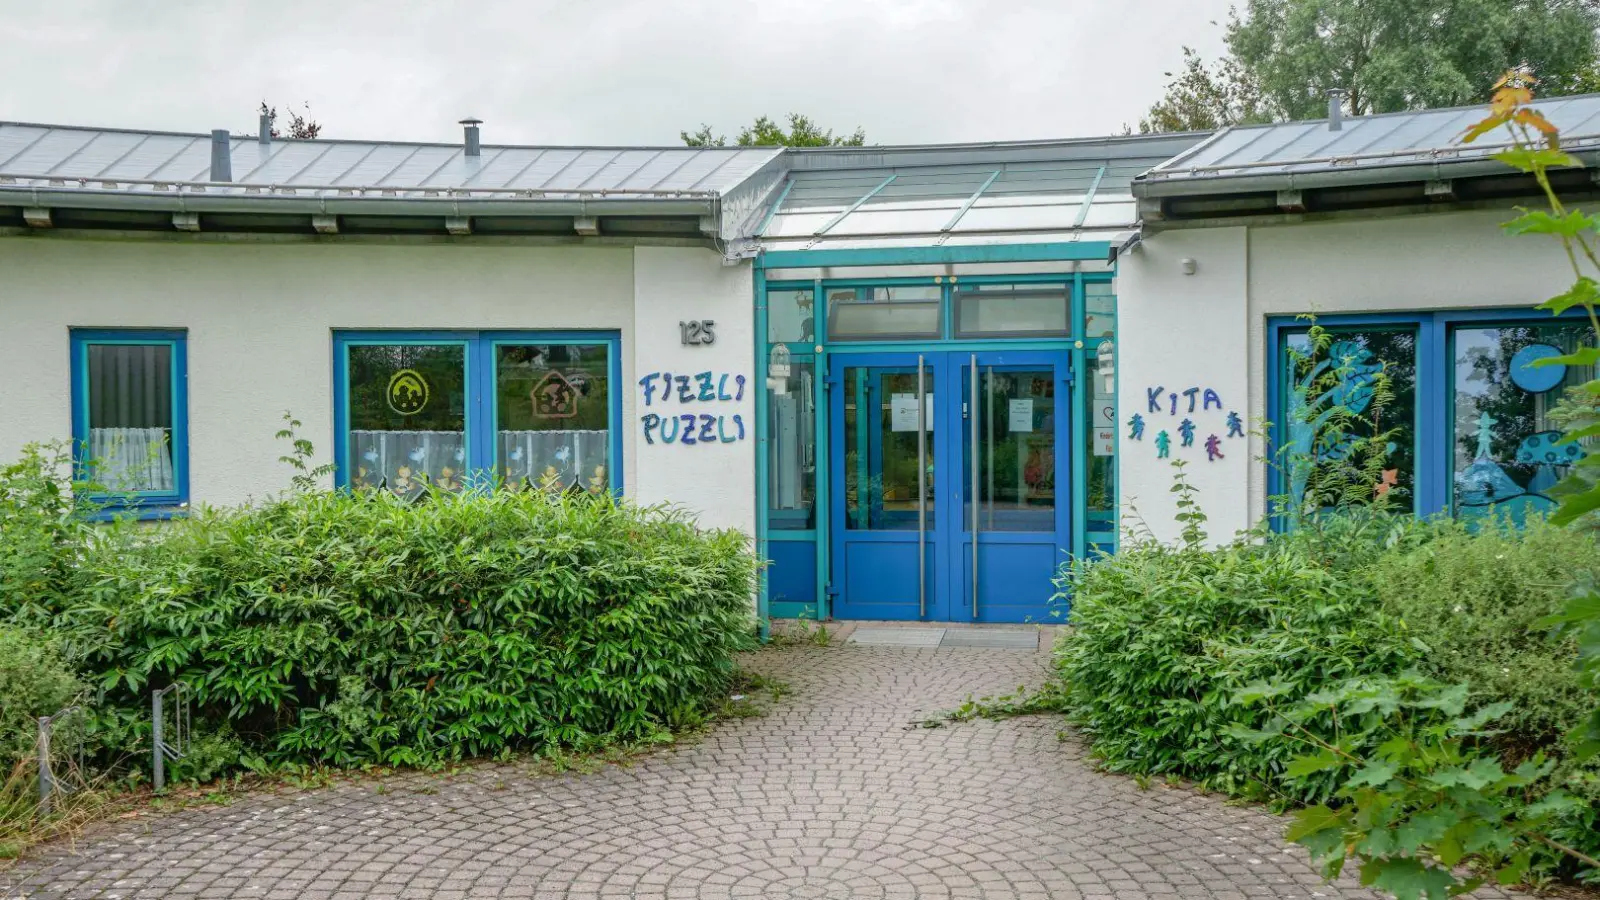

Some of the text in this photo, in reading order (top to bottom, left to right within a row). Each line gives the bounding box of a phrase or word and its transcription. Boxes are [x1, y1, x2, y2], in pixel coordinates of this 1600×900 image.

[679, 320, 715, 345] 125
[639, 371, 746, 406] FIZZLI
[641, 413, 745, 445] PUZZLI
